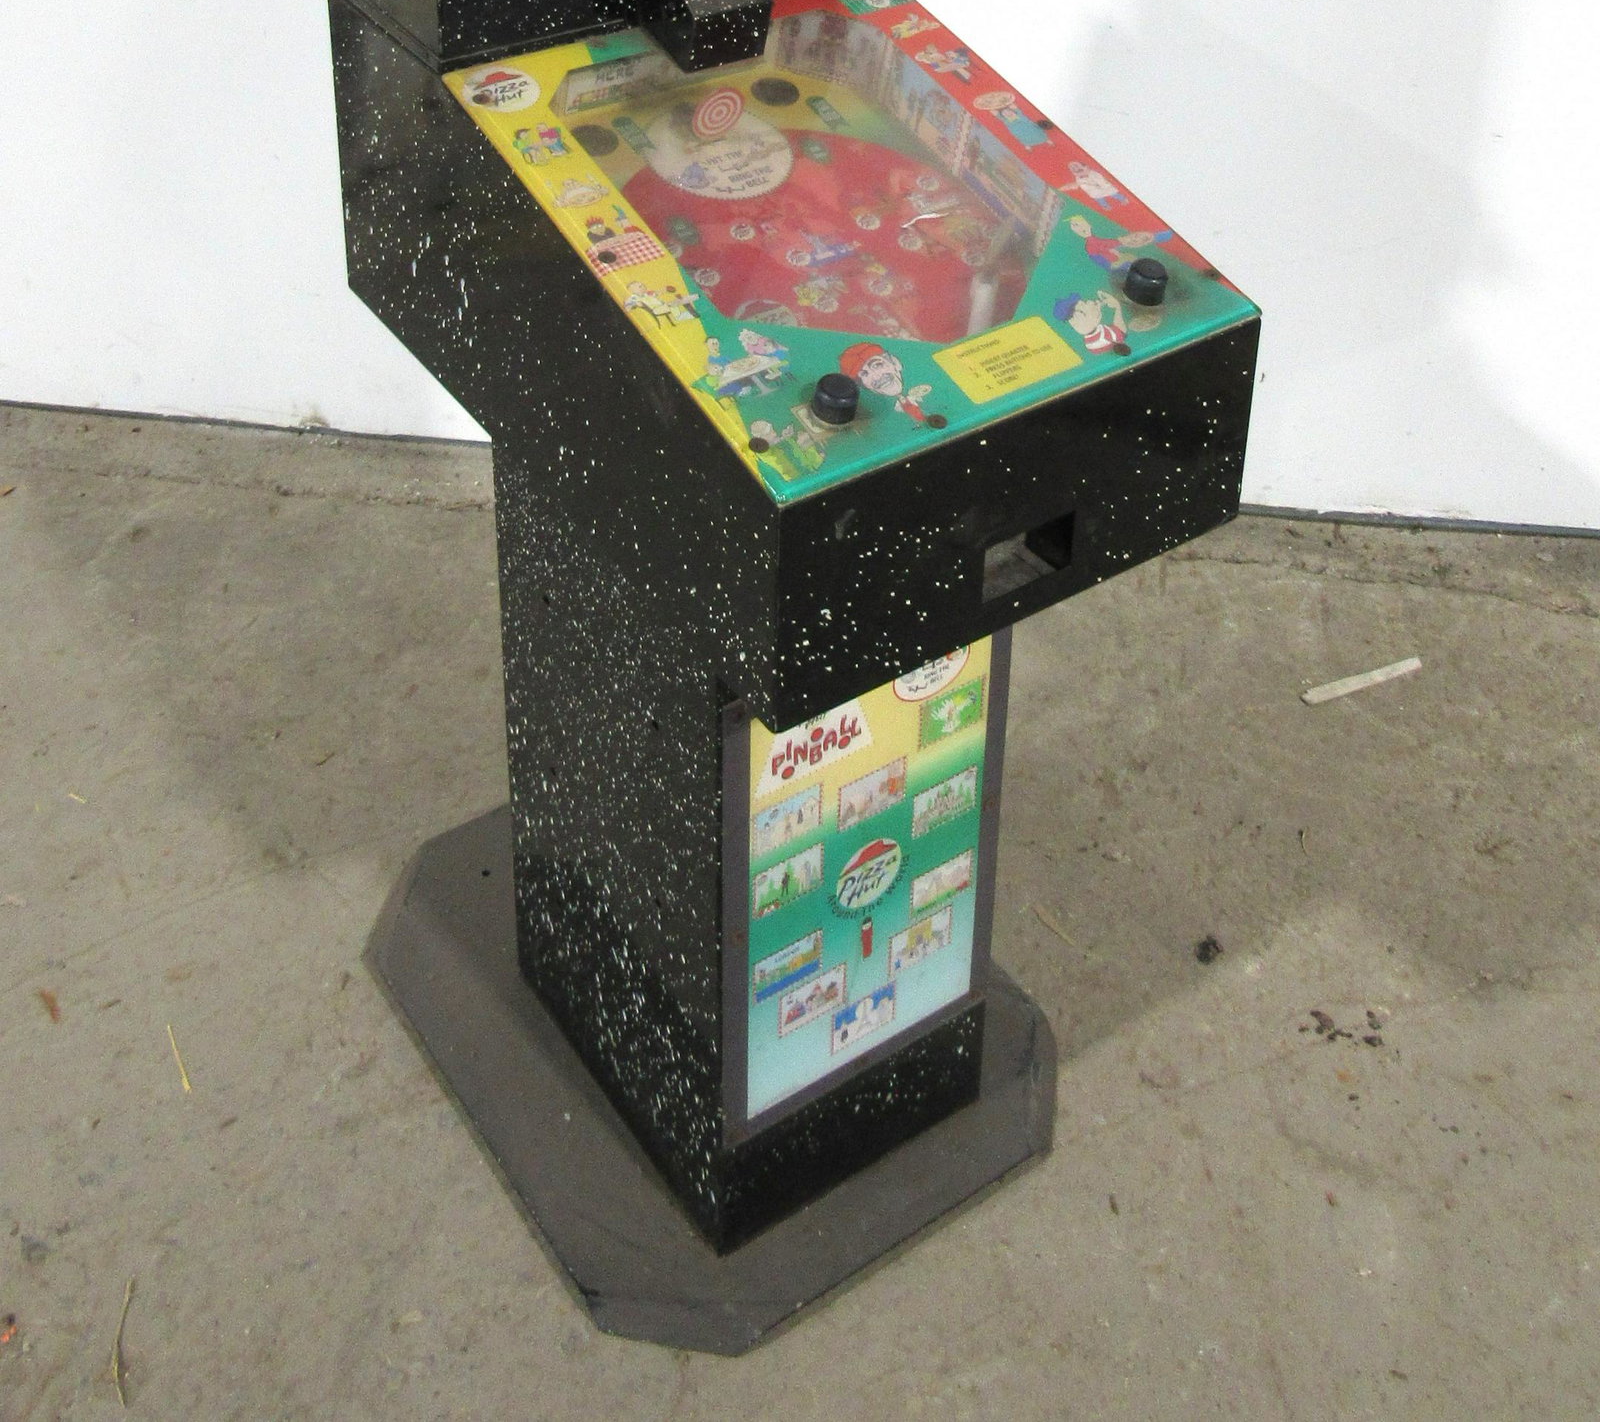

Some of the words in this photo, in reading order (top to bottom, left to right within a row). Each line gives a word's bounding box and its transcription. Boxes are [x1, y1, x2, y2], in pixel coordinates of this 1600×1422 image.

[494, 90, 524, 106] Hut
[771, 713, 862, 777] PINBALL
[838, 854, 897, 901] Pizza
[846, 870, 886, 907] Hut
